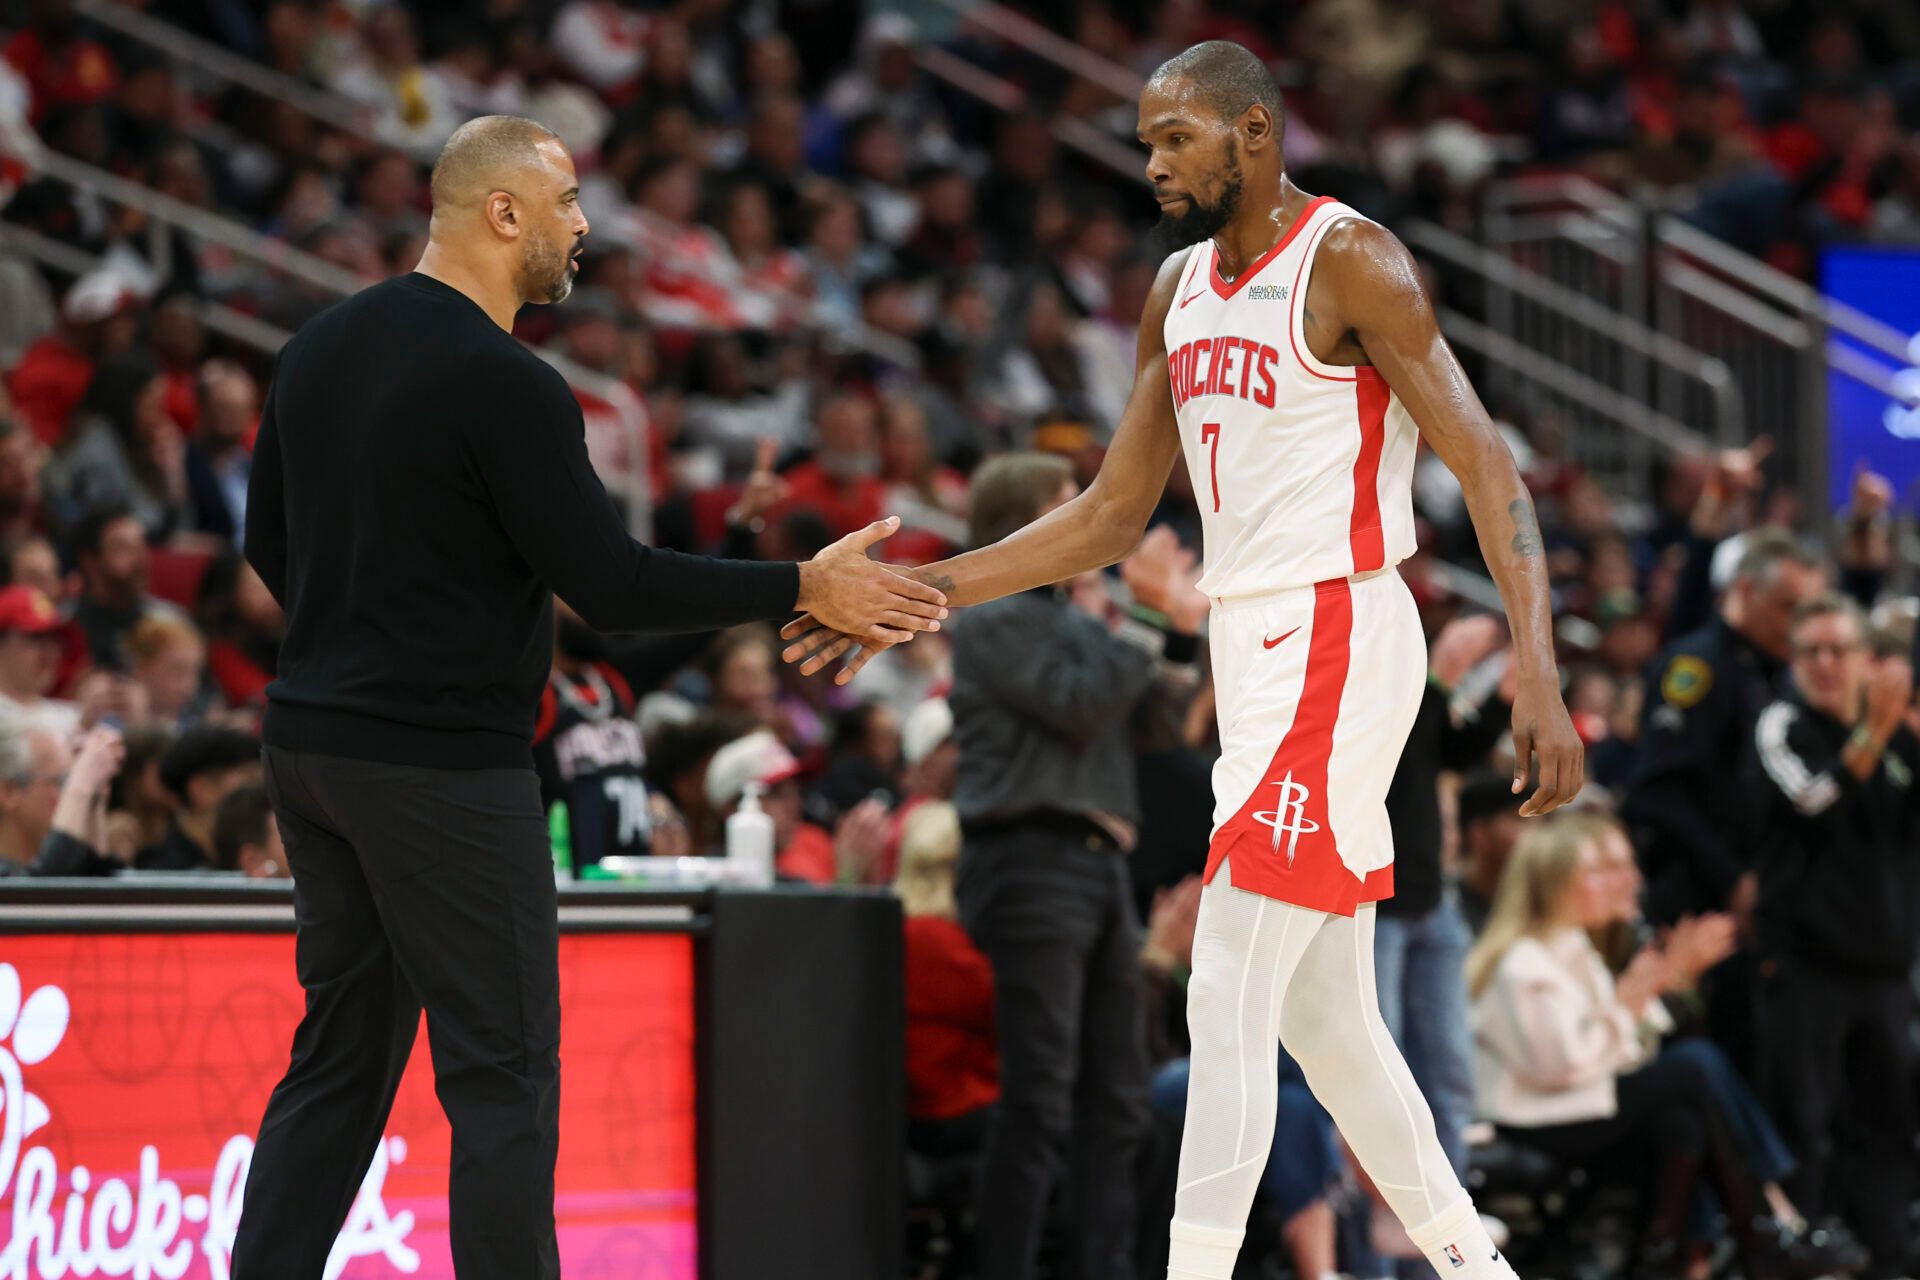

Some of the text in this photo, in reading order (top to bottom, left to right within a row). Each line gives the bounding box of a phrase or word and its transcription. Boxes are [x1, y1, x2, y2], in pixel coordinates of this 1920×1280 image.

[1248, 292, 1288, 300] HERMANN
[1249, 285, 1288, 293] MEMORIAL
[1168, 336, 1279, 412] ROCKETS
[1201, 423, 1221, 513] 7
